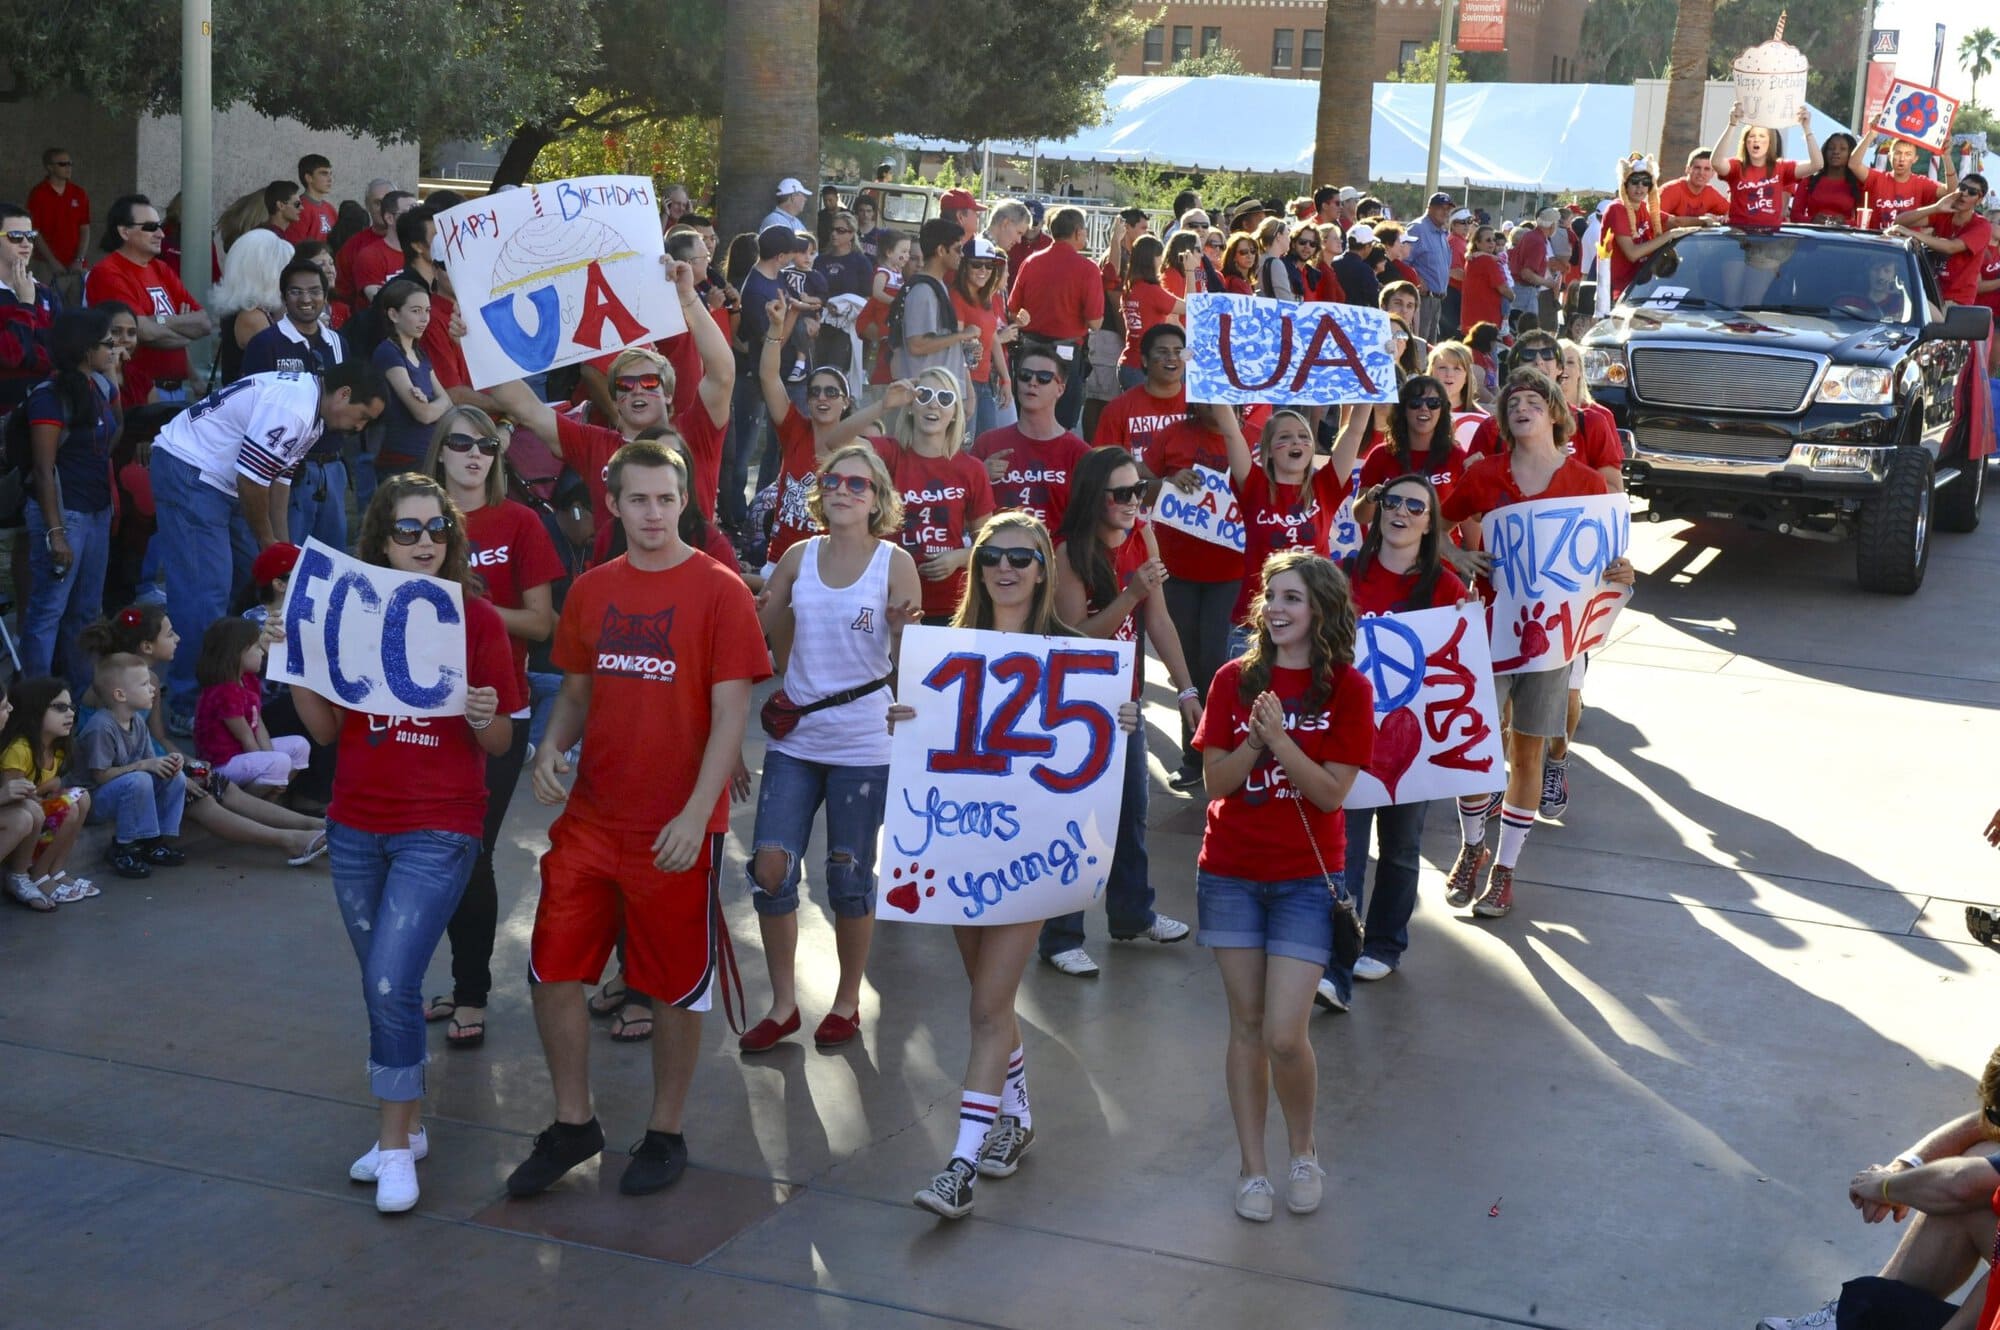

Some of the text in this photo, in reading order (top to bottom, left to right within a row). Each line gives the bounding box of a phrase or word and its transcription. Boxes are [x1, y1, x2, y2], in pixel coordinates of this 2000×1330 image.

[1465, 3, 1501, 12] Women's
[1462, 13, 1503, 24] Swimming
[1873, 31, 1897, 54] A
[1747, 199, 1773, 210] LIFE
[439, 182, 650, 261] HAPPY BIRTHDAY
[480, 284, 560, 373] U
[572, 259, 650, 351] A
[1219, 313, 1378, 394] UA
[1129, 413, 1188, 433] ARIZO
[899, 487, 966, 505] UBBIES
[1019, 487, 1031, 505] 4
[918, 507, 931, 524] 4
[1160, 493, 1209, 530] OVER
[902, 526, 947, 546] LIFE
[1286, 527, 1298, 543] 4
[285, 546, 462, 711] FCC
[851, 606, 874, 634] A
[922, 649, 1119, 794] 125
[395, 730, 440, 747] 2010-2011
[1246, 765, 1288, 791] LIF
[948, 820, 1098, 919] young!
